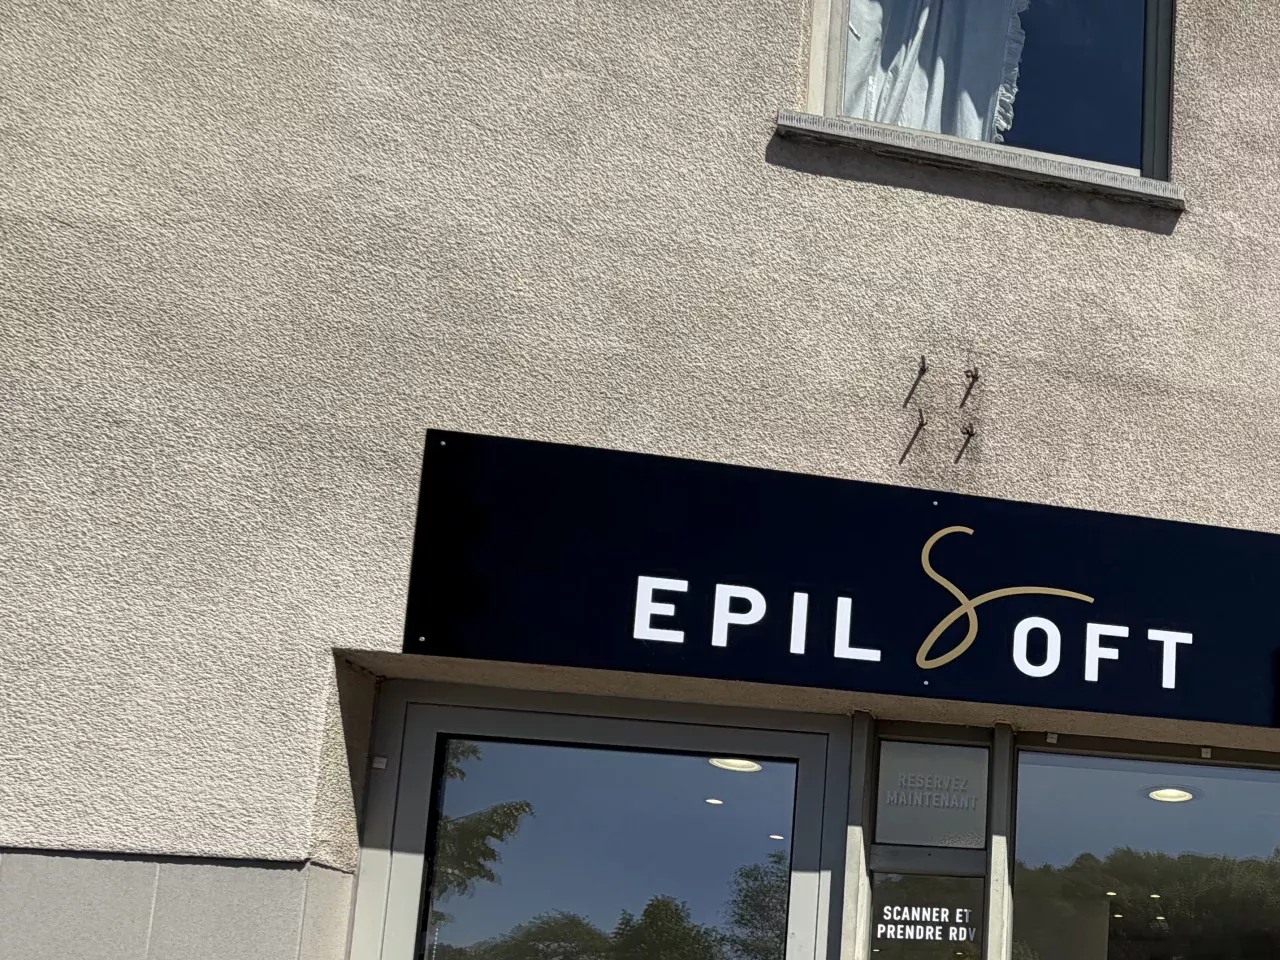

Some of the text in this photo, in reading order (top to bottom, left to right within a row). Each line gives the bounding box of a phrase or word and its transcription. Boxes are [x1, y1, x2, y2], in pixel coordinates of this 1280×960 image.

[885, 789, 978, 811] MAINTENANT
[883, 905, 972, 924] SCANNER ET
[877, 924, 976, 942] PRENDRE RDV
